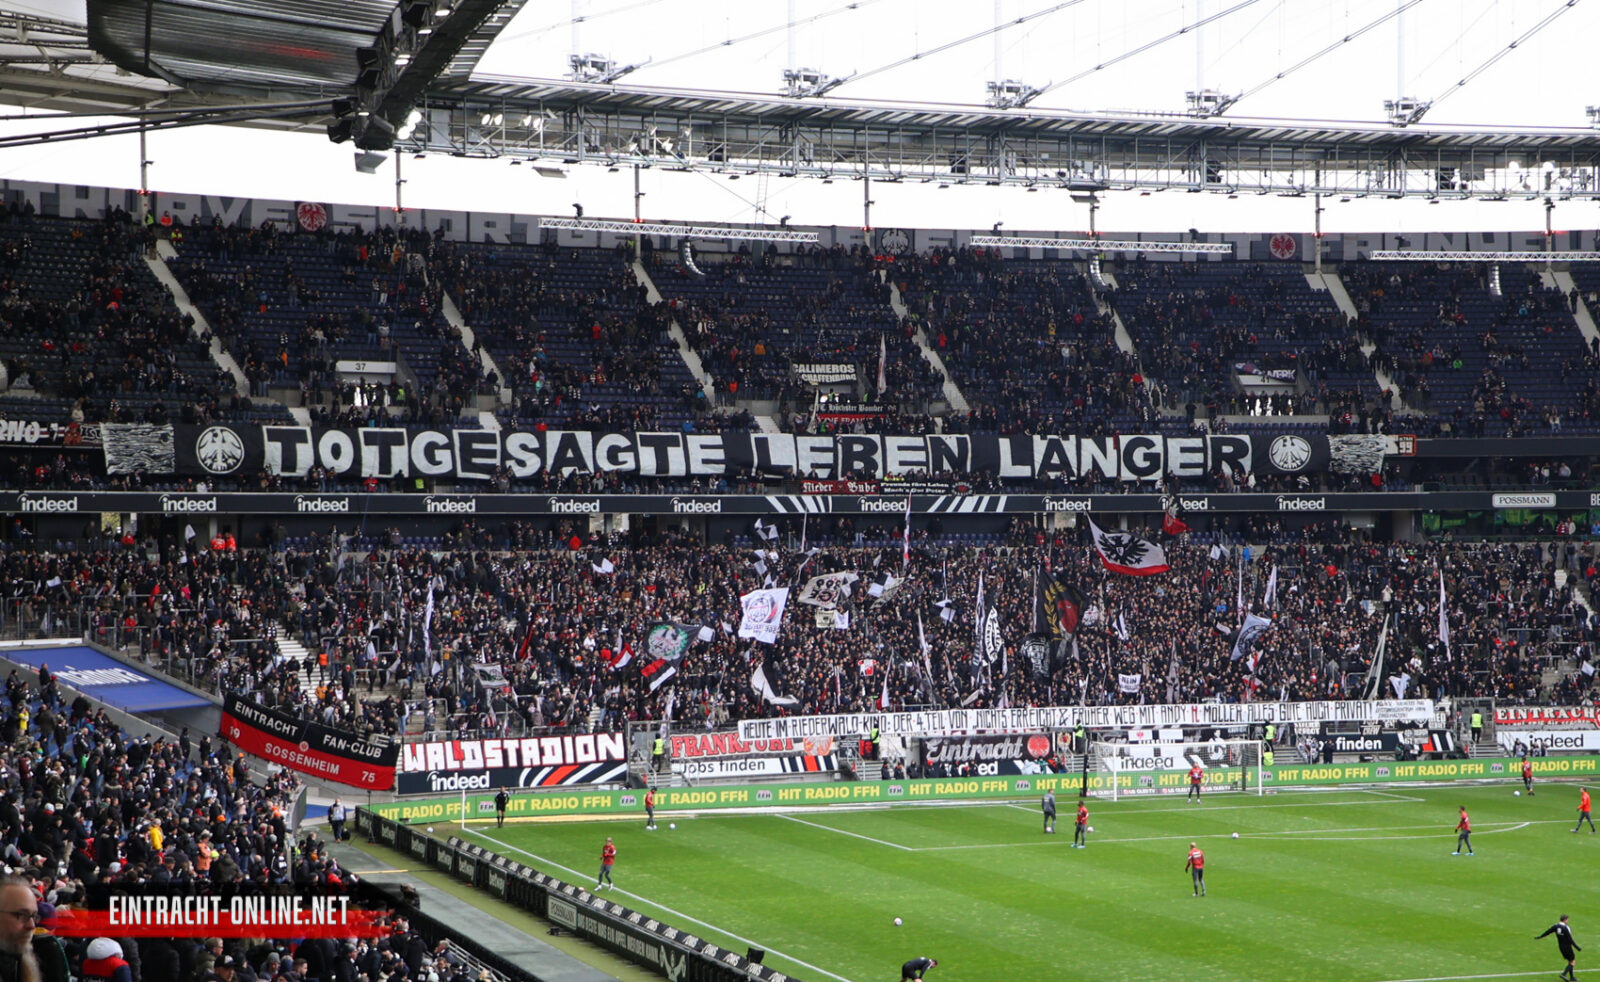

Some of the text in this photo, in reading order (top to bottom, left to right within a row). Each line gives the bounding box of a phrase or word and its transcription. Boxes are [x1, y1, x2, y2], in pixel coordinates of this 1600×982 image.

[355, 362, 366, 371] 37
[792, 363, 855, 373] CALIMEROS
[262, 425, 1252, 481] TOTGESAGTE LEBEN LÄNGER
[20, 496, 78, 512] indeed
[162, 496, 217, 512] indeed
[297, 496, 349, 511] indeed
[426, 497, 476, 513] indeed
[551, 498, 600, 513] indeed
[673, 498, 721, 513] indeed
[861, 497, 908, 512] indeed
[1045, 497, 1092, 512] indeed
[1279, 496, 1325, 510] indeed
[1499, 496, 1550, 504] POSSMANN
[743, 719, 772, 739] HEUTE
[775, 719, 788, 736] IM
[893, 714, 912, 733] DER
[950, 710, 968, 729] VON
[1010, 707, 1056, 728] ERREICHT
[1114, 706, 1136, 725] WEG
[1139, 705, 1156, 724] MIT
[1160, 704, 1187, 723] ANDY
[1248, 702, 1275, 721] ALLES
[1279, 702, 1301, 720] GUTE
[1305, 701, 1330, 720] AUCH
[1334, 701, 1373, 720] PRIVAT!
[234, 700, 383, 759] EINTRACHT FAN-CLUB
[1336, 736, 1382, 751] finden
[1529, 733, 1584, 748] indeed
[229, 726, 376, 783] 19 75
[402, 732, 625, 772] WALDSTADION
[925, 736, 1024, 762] Eintracht
[265, 742, 341, 775] SOSSENHEIM
[720, 758, 766, 772] finden
[1531, 760, 1570, 772] RADIO
[1572, 759, 1596, 770] FFH
[1279, 767, 1369, 780] HIT RADIO FFH
[1395, 763, 1483, 777] HIT RADIO FFH
[430, 770, 490, 791] indeed
[1036, 779, 1058, 789] HIT
[1159, 773, 1181, 786] HIT
[778, 785, 880, 800] HIT RADIO FFH
[909, 780, 1008, 795] HIT RADIO FFH
[531, 797, 580, 810] RADIO
[583, 795, 611, 808] FFH
[670, 792, 717, 804] RADIO
[720, 790, 748, 802] FFH
[379, 803, 471, 820] HIT RADIO FFH
